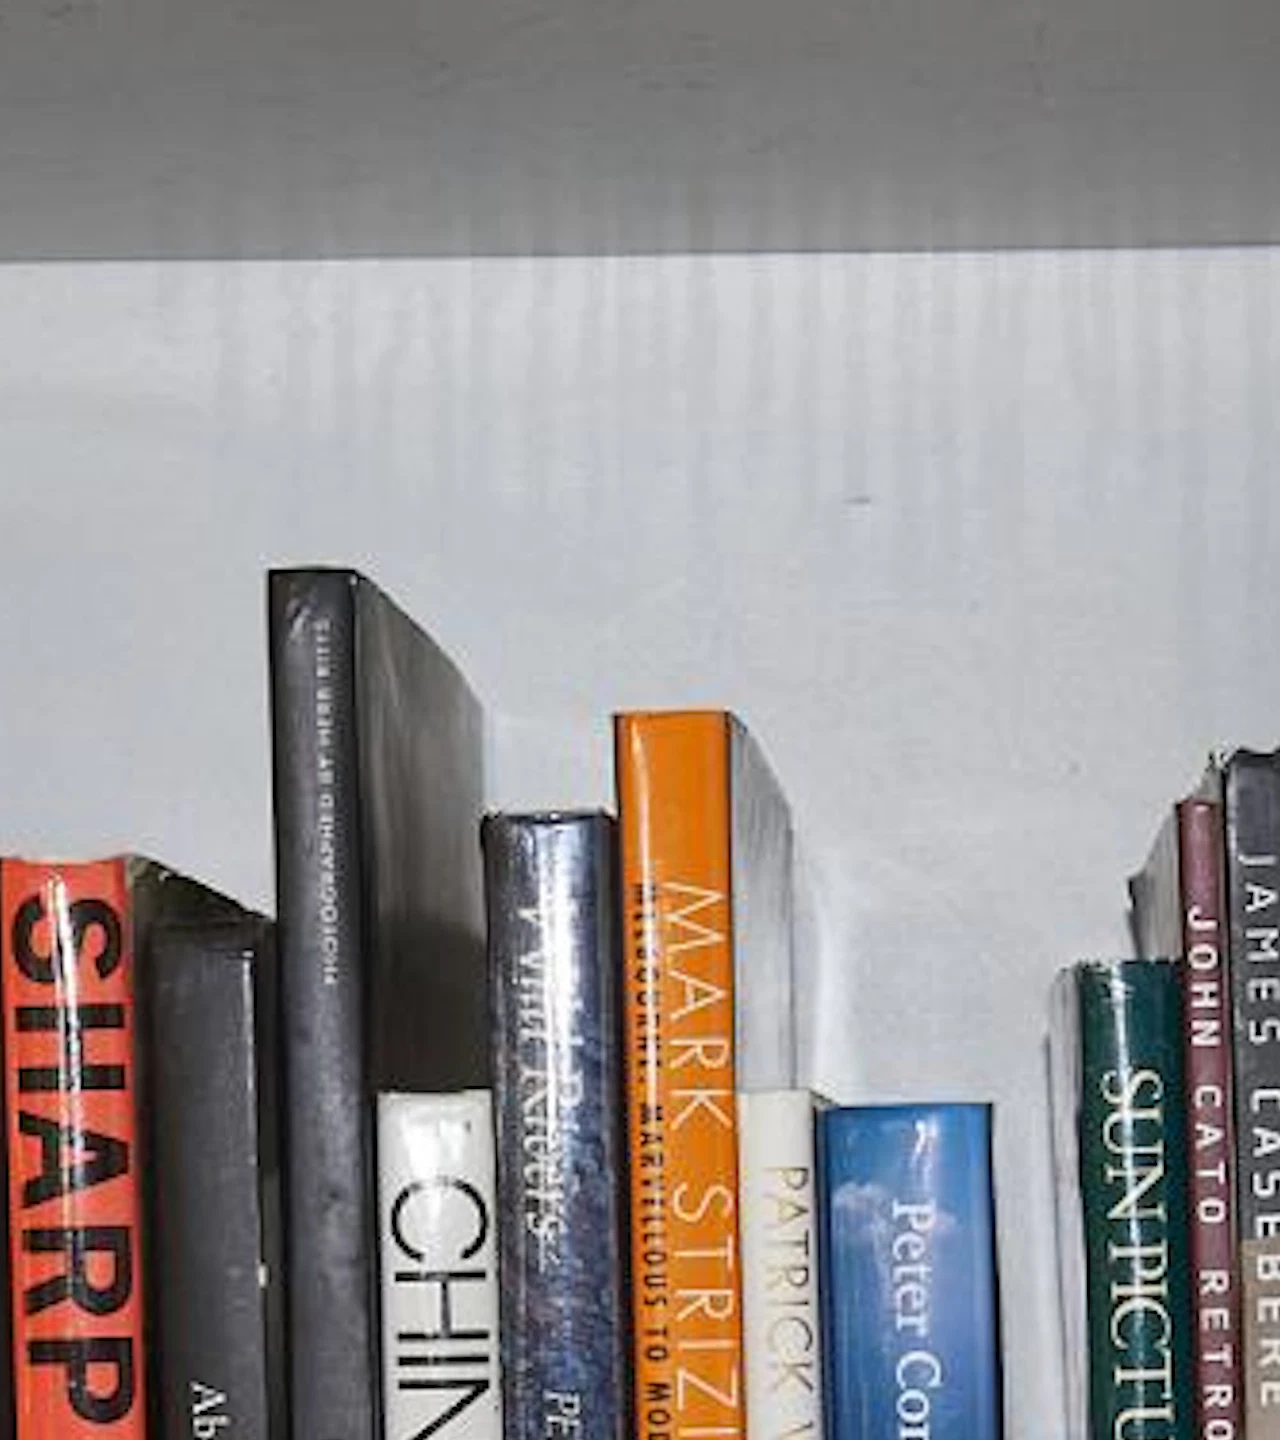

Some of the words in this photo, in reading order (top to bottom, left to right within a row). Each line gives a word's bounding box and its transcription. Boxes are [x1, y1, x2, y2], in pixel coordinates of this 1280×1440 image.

[662, 881, 733, 1131] MARK
[1189, 904, 1221, 1047] JOHN
[14, 893, 134, 1427] SHARP
[638, 1103, 669, 1309] MARVELLOUS
[1100, 1065, 1168, 1224] SUN
[1196, 1083, 1226, 1224] CATO
[643, 1327, 669, 1363] TO
[763, 1166, 815, 1395] PATRICK
[892, 1199, 938, 1338] Peter
